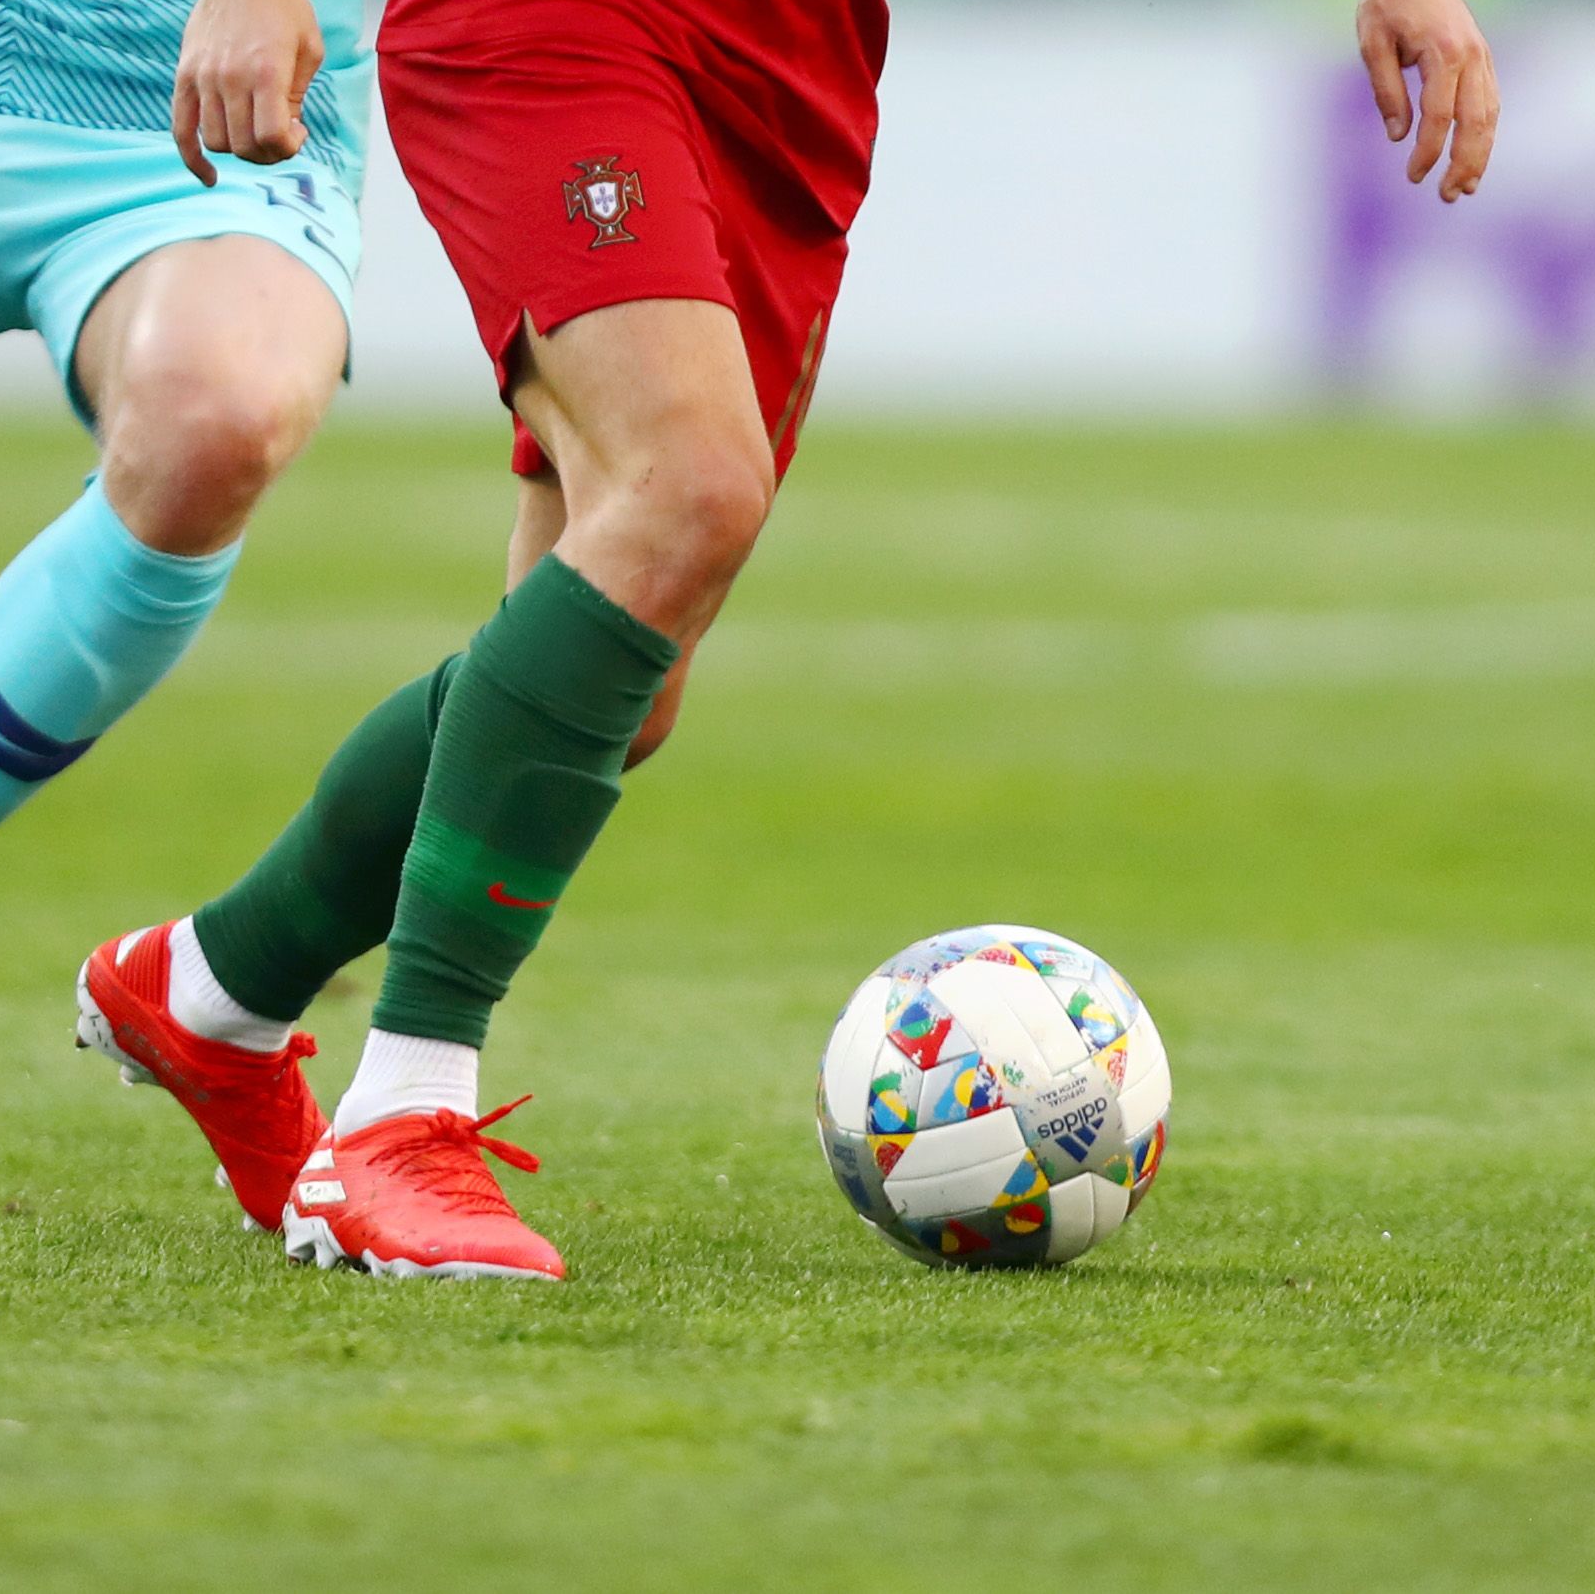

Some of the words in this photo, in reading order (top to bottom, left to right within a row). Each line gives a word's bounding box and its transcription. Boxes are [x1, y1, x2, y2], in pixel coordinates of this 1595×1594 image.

[1059, 1077, 1087, 1094] MATCH
[1036, 1090, 1058, 1103] BALL
[1049, 1087, 1086, 1107] OFFICIAL
[1037, 1097, 1107, 1138] adidas
